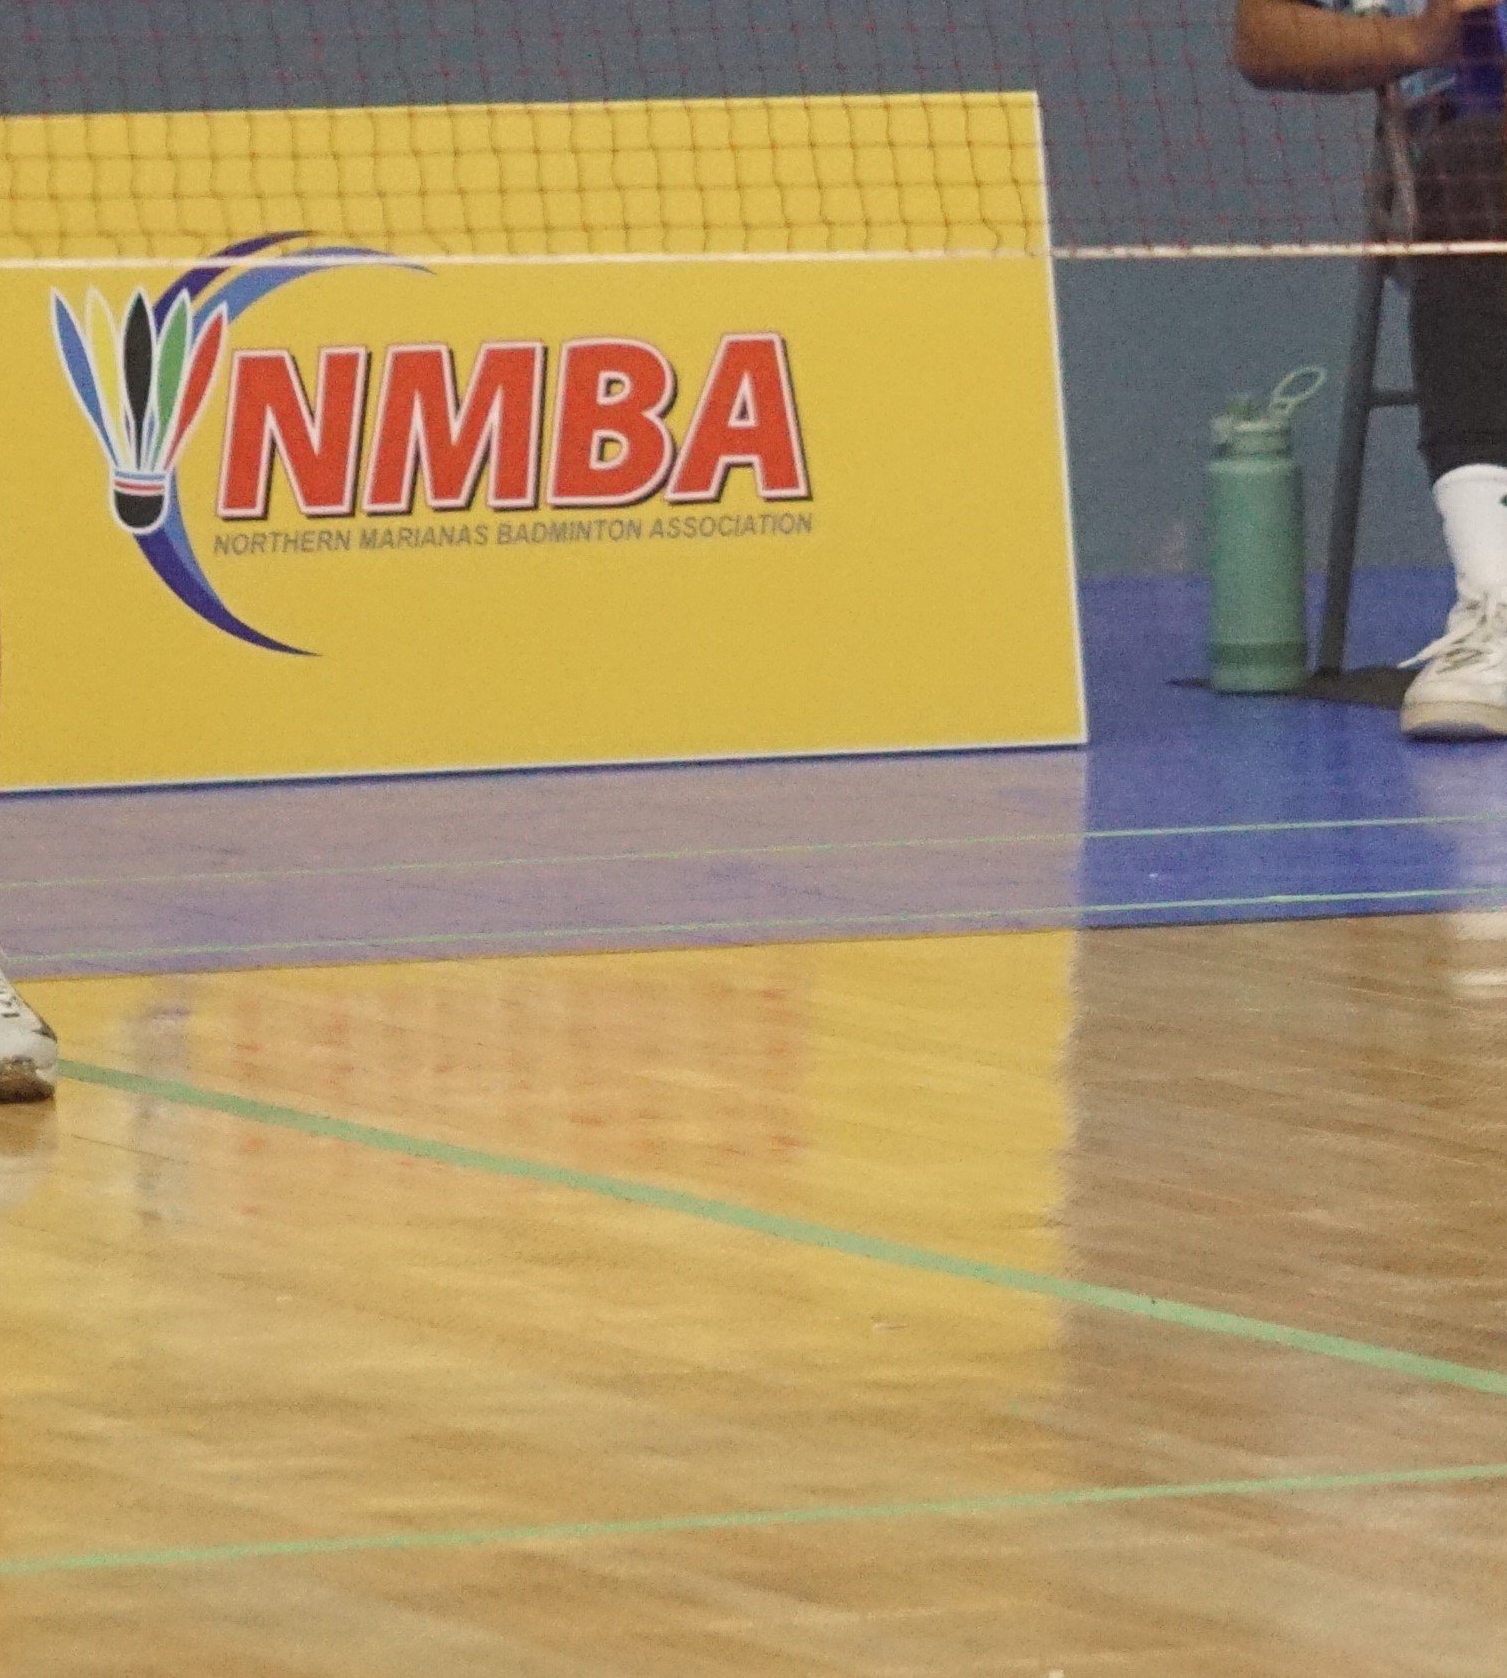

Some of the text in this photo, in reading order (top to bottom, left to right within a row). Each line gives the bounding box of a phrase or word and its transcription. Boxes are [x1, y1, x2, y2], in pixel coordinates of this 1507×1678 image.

[216, 331, 814, 520] NMBA
[212, 511, 813, 556] NORTHERN MARIANAS BADMINTON ASSOCIATION
